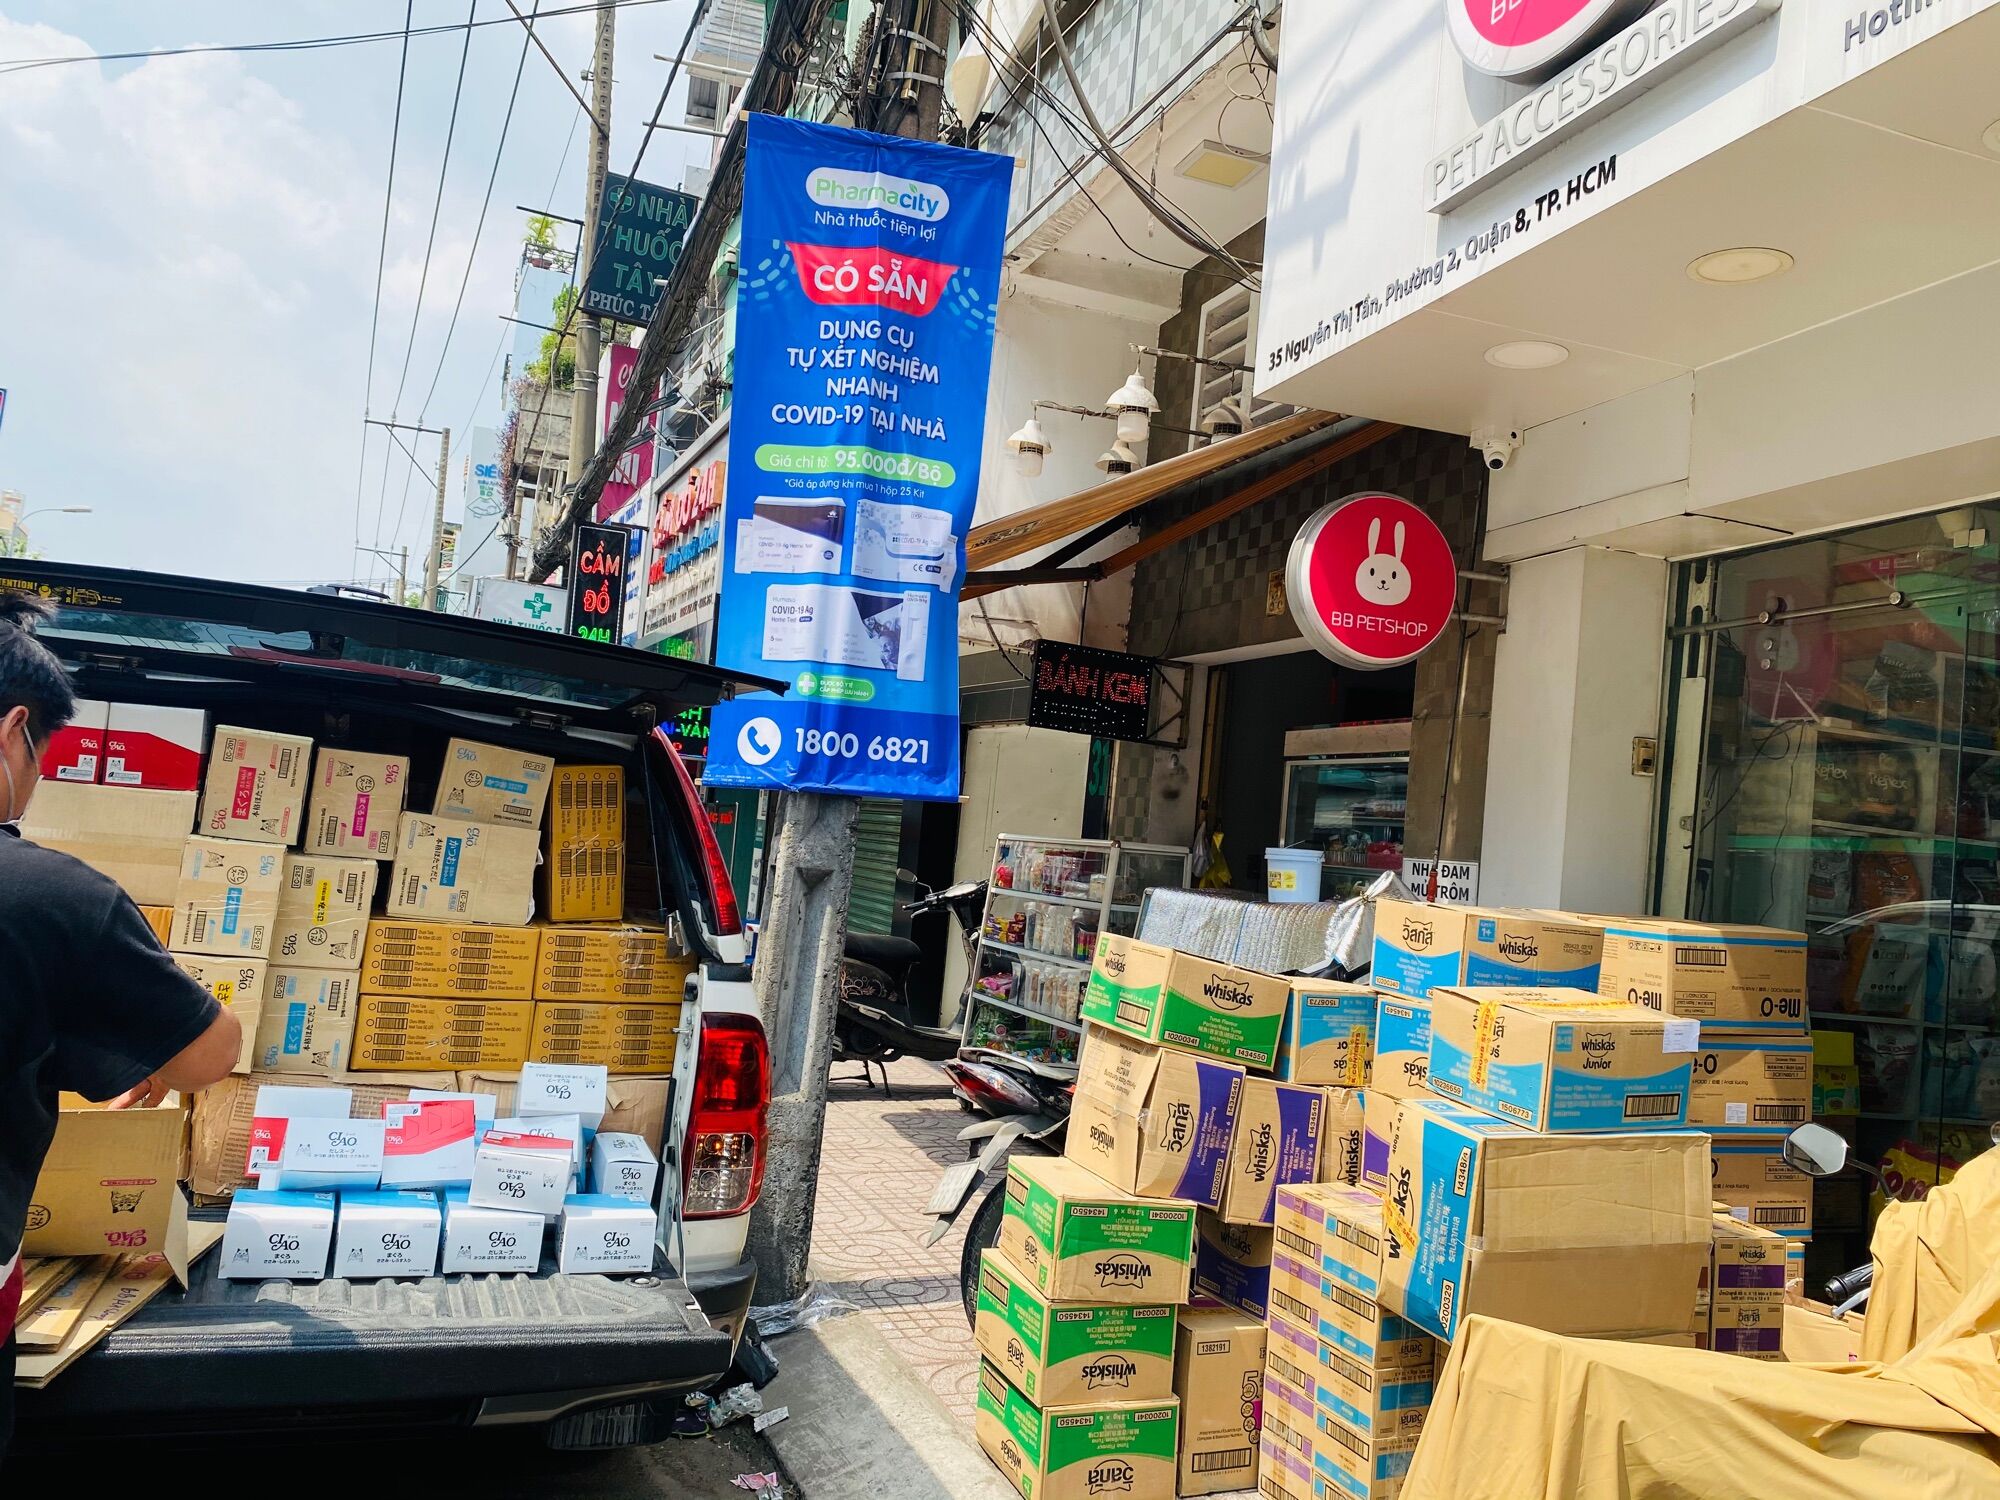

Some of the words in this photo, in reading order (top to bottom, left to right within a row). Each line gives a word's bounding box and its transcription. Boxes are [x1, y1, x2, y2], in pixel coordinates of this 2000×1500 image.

[1433, 133, 1484, 202] PET
[815, 179, 940, 217] Pharmacity
[637, 193, 688, 229] NHÀ
[815, 211, 844, 226] Nhà
[849, 211, 887, 229] thuốc
[890, 218, 916, 237] tiện
[920, 224, 937, 241] lợi
[1268, 351, 1283, 371] 35
[1285, 320, 1331, 363] Nguyễn
[1333, 306, 1353, 335] Thị
[1385, 263, 1444, 307] Phường
[1447, 250, 1461, 273] 2,
[1464, 222, 1511, 260] Quận
[1514, 208, 1531, 234] 8,
[1535, 188, 1562, 222] TP.
[1567, 154, 1617, 206] HCM
[613, 261, 663, 297] TÂY
[814, 260, 859, 292] CÓ
[868, 259, 927, 305] SẴN
[588, 290, 635, 316] PHÚC
[640, 303, 657, 321] T
[819, 320, 882, 345] DỤNG
[887, 325, 915, 349] CỤ
[787, 347, 817, 371] TỰ
[820, 345, 856, 368] XÉT
[860, 349, 940, 384] NGHIỆM
[826, 378, 899, 402] NHANH
[771, 404, 864, 425] COVID-19
[870, 406, 895, 434] TẠI
[901, 412, 947, 441] NHÀ
[475, 464, 503, 479] SIÊ
[769, 453, 792, 468] Giá
[795, 453, 814, 468] chỉ
[834, 450, 942, 486] 95.000đ/Bộ
[805, 478, 818, 491] áp
[819, 478, 840, 491] dụng
[841, 478, 854, 489] khi
[855, 481, 873, 492] mua
[880, 484, 898, 497] hộp
[900, 486, 911, 497] 25
[913, 488, 925, 499] Kit
[581, 541, 620, 577] CẦM
[583, 580, 611, 614] ĐỒ
[772, 605, 804, 615] COVID-19
[805, 605, 814, 616] Ag
[578, 626, 611, 643] 24H
[1331, 611, 1354, 628] BB
[1356, 614, 1428, 637] PETSHOP
[1038, 654, 1099, 698] BÁNH
[1102, 671, 1146, 705] KEM
[457, 748, 478, 762] CIAO
[795, 728, 859, 759] 1800
[867, 735, 929, 764] 6821
[385, 765, 400, 785] CIAO
[235, 790, 250, 817] まぐろ
[211, 807, 228, 830] CIAO
[466, 827, 480, 850] CIAO
[444, 839, 459, 868] かつお
[259, 855, 275, 876] CIAO
[1441, 865, 1470, 880] ĐAM
[1411, 879, 1429, 896] MỦ
[1435, 882, 1469, 901] TRÔM
[252, 926, 263, 949] IC-212
[1402, 923, 1434, 947] วิสกัส
[1481, 927, 1491, 937] 1+
[282, 934, 297, 955] CIAO
[1499, 942, 1538, 957] whiskas
[1105, 957, 1126, 974] whiskas
[238, 968, 255, 992] CIAO
[274, 975, 287, 999] IC-202
[1204, 982, 1254, 1006] whiskas
[1760, 997, 1800, 1018] Me-O
[288, 1024, 300, 1052] まぐろ
[1167, 1032, 1198, 1045] 10200341
[1582, 1039, 1615, 1052] whiskas
[264, 1045, 278, 1067] CIAO
[1237, 1049, 1266, 1061] 1434550
[1583, 1058, 1611, 1070] Junior
[546, 1084, 571, 1100] CIAO
[1227, 1080, 1239, 1115] 1434548
[1308, 1100, 1319, 1137] 1434548
[1501, 1102, 1531, 1118] 1506773
[329, 1131, 357, 1146] CIAO
[1090, 1127, 1115, 1150] whiskas
[1167, 1103, 1191, 1153] วิสกัส
[1253, 1123, 1271, 1183] whiskas
[1349, 1130, 1360, 1185] whiskas
[621, 1167, 641, 1180] CIAO
[1211, 1159, 1224, 1201] 10200339
[499, 1181, 526, 1199] CIAO
[1073, 1207, 1106, 1217] 1434550
[1433, 1205, 1441, 1229] Ikan
[1437, 1178, 1445, 1203] Laut
[1151, 1211, 1187, 1220] 10200341
[106, 1228, 148, 1248] CIAO
[1419, 1246, 1430, 1274] Ocean
[1428, 1181, 1437, 1222] Flavour
[269, 1233, 300, 1250] CIAO
[382, 1233, 411, 1250] CIAO
[489, 1231, 517, 1247] CIAO
[604, 1231, 630, 1247] CIAO
[1739, 1250, 1766, 1259] whiskas
[1095, 1263, 1151, 1277] whiskas
[1058, 1311, 1091, 1320] 1434550
[1135, 1309, 1168, 1317] 10200341
[1441, 1284, 1453, 1329] 0200329
[1201, 1343, 1226, 1353] 1382191
[1082, 1363, 1136, 1380] whiskas
[1059, 1417, 1092, 1426] 1434550
[1137, 1412, 1170, 1421] 10200341
[1000, 1439, 1022, 1470] whiskas
[1085, 1466, 1134, 1486] วิสกัส
